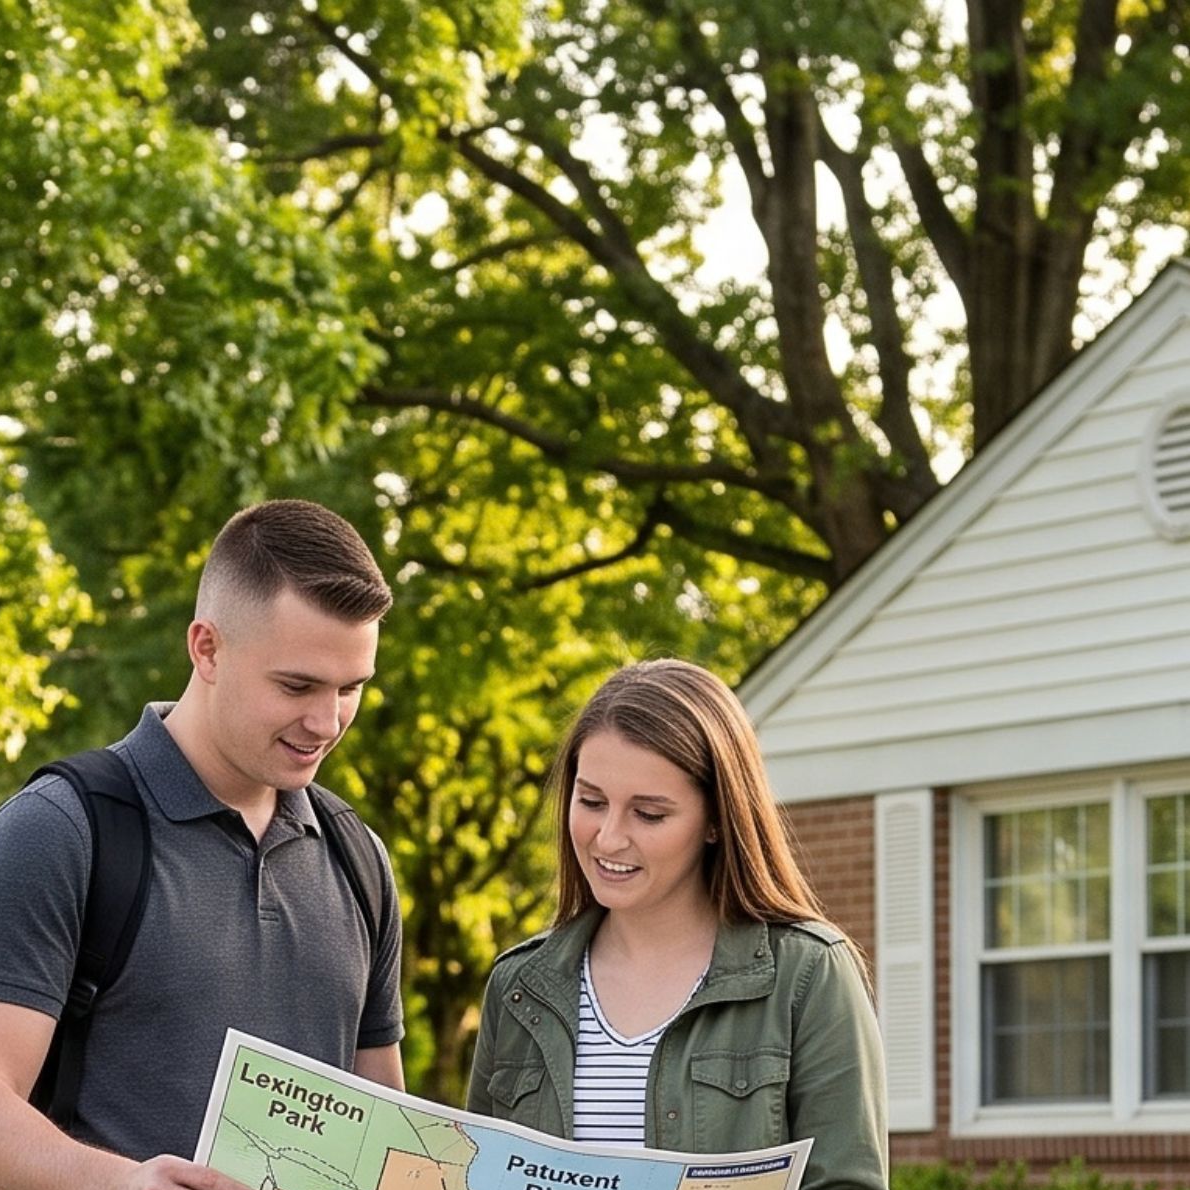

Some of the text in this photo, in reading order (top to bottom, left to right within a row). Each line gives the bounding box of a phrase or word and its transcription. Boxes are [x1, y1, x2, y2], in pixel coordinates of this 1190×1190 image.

[240, 1062, 364, 1122] Lexington
[268, 1099, 326, 1135] Park
[506, 1154, 621, 1190] Patuxent
